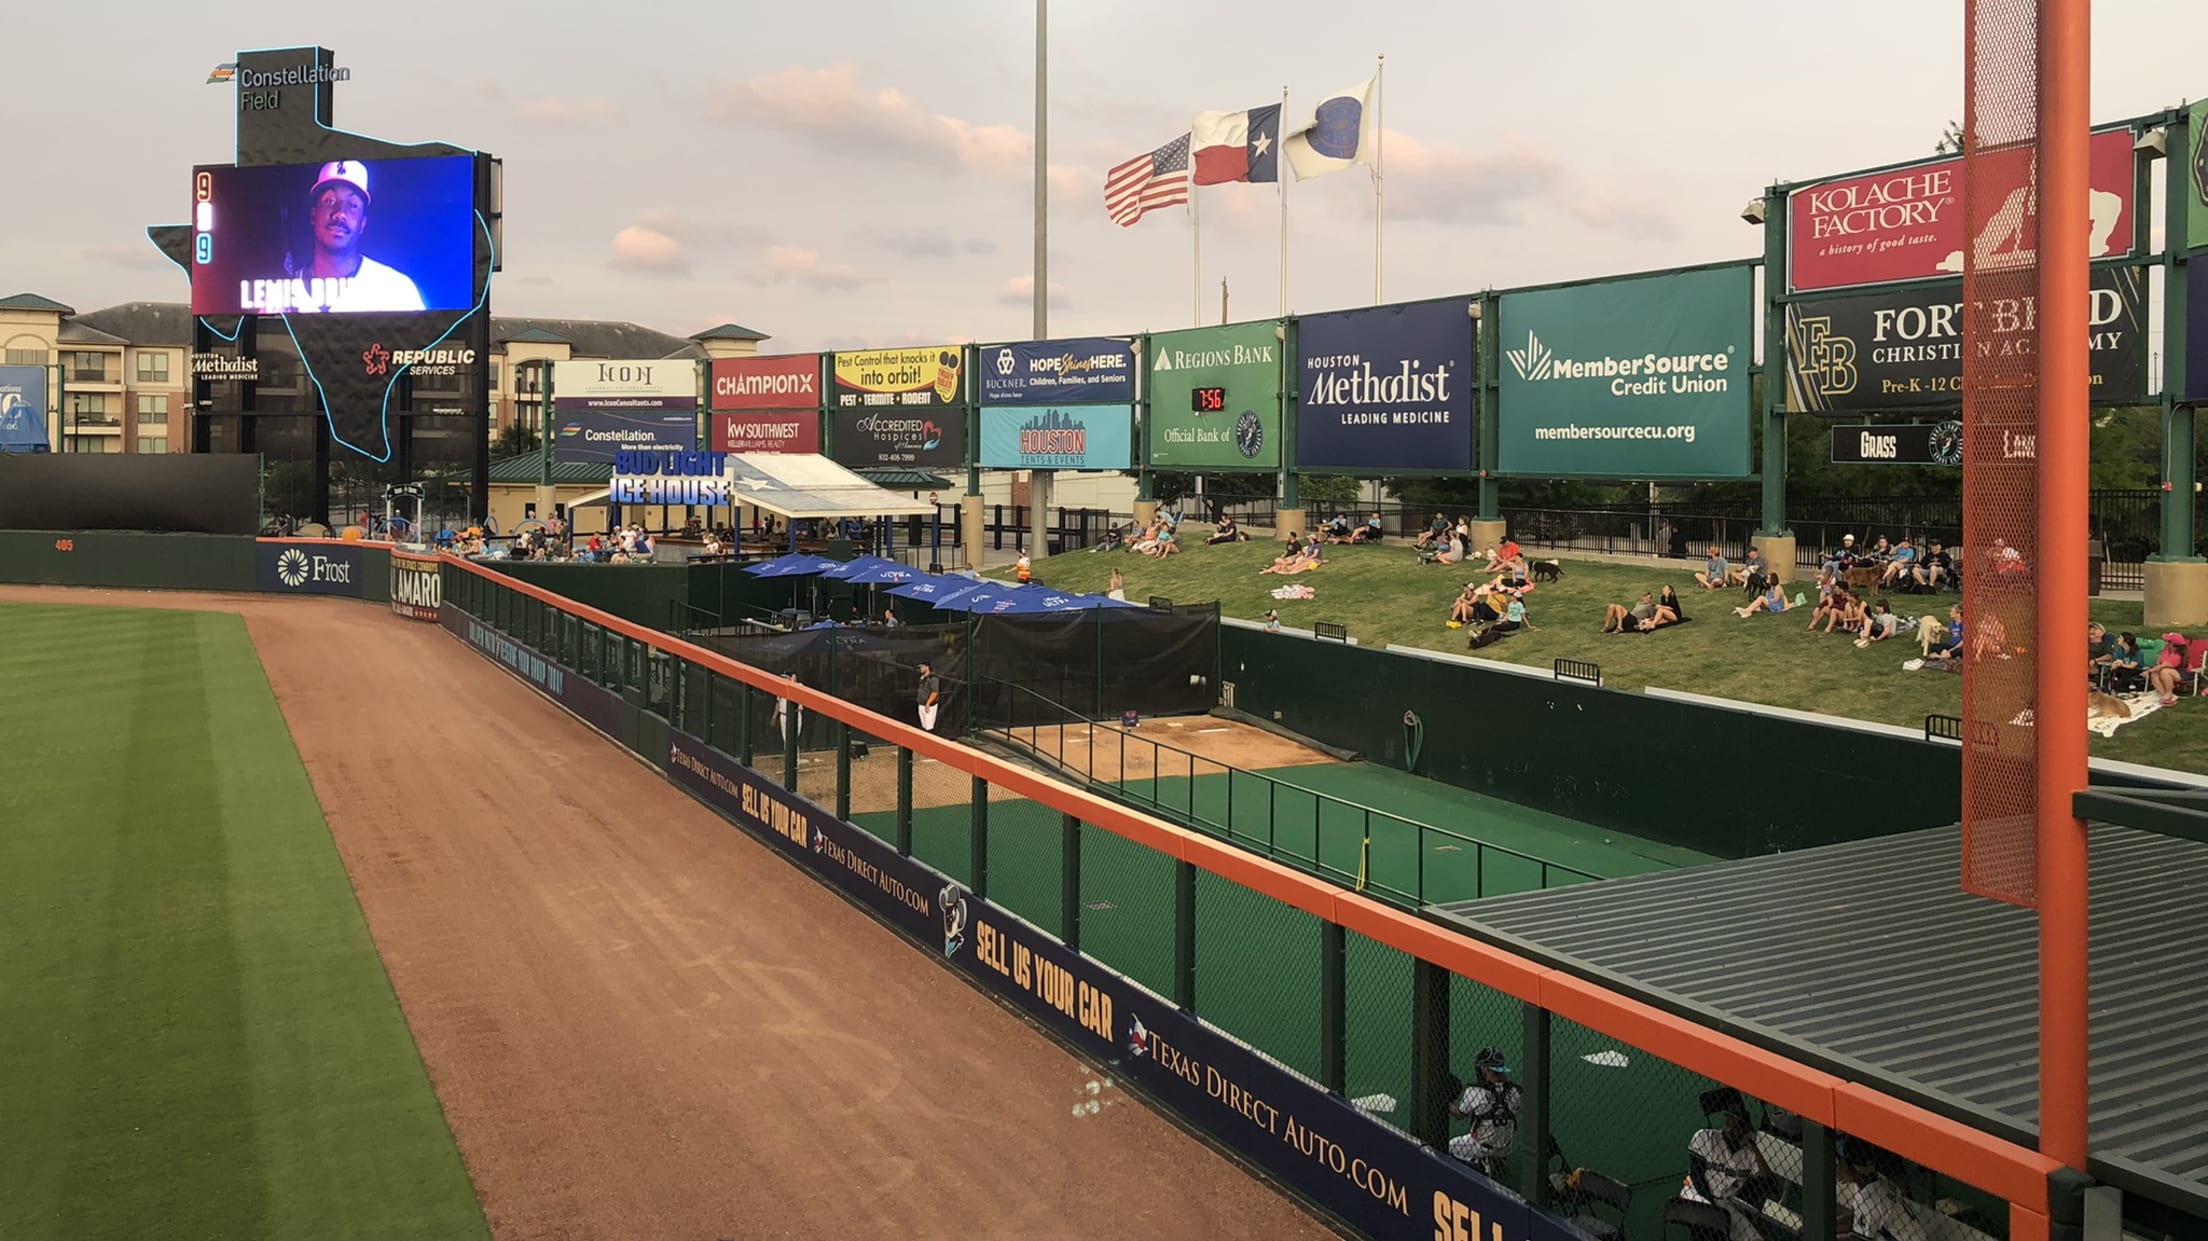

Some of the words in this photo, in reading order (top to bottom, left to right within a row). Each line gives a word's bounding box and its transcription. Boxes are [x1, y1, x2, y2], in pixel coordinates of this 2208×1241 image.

[241, 63, 350, 87] Constellation
[240, 90, 279, 110] Field
[1809, 170, 1951, 215] KOLACHE
[1812, 197, 1945, 239] FACTORY
[1819, 248, 1825, 256] a
[1829, 242, 1863, 256] history
[1866, 238, 1879, 251] of
[1880, 234, 1904, 251] good
[1908, 233, 1937, 245] taste.
[1993, 289, 2122, 333] BD
[2000, 332, 2122, 356] ACMY
[192, 356, 258, 372] Methodist
[392, 350, 476, 365] REPUBLIC
[838, 355, 853, 367] Pest
[854, 353, 882, 367] Control
[883, 352, 899, 365] that
[900, 351, 928, 364] knocks
[930, 350, 936, 363] it
[1030, 358, 1062, 372] HOPE
[1090, 354, 1126, 369] HERE.
[1175, 349, 1231, 370] REGIONS
[1234, 344, 1272, 365] BANK
[1307, 354, 1360, 369] HOUSTON
[1553, 352, 1728, 379] MemberSource
[409, 366, 456, 375] SERVICES
[861, 368, 884, 386] into
[888, 365, 921, 385] orbit!
[1088, 375, 1100, 384] and
[1101, 373, 1126, 383] Seniors
[986, 378, 1026, 389] BUCKNER
[1307, 360, 1450, 405] Methodist
[1611, 377, 1666, 396] Credit
[1671, 374, 1727, 393] Union
[1882, 377, 1921, 394] Pre-K
[840, 394, 857, 406] PEST
[864, 393, 894, 406] TERMITE
[902, 392, 931, 405] RODENT
[1200, 389, 1221, 409] 7:56
[857, 413, 923, 432] ACCREDITED
[1341, 412, 1388, 424] LEADING
[1392, 411, 1450, 424] MEDICINE
[585, 429, 655, 441] Constellation
[746, 423, 799, 438] SOUTHWEST
[874, 432, 922, 442] Hospices
[1164, 427, 1195, 442] Official
[1197, 427, 1219, 442] Bank
[1221, 427, 1231, 442] of
[1535, 423, 1695, 442] membersourcecu.org
[1020, 428, 1086, 454] HOUSTON
[615, 450, 660, 475] BUD
[661, 449, 727, 477] LIGHT
[1021, 455, 1045, 464] TENTS
[1055, 455, 1085, 464] EVENTS
[610, 478, 647, 504] ICE
[651, 479, 731, 506] HOUSE
[56, 539, 73, 551] 405
[312, 556, 350, 583] Frost
[742, 782, 759, 818] SELL
[760, 792, 770, 825] US
[771, 798, 789, 838] YOUR
[790, 810, 808, 849] CAR
[823, 835, 846, 865] TEXAS
[847, 849, 878, 885] DIRECT
[879, 870, 929, 917] AUTO.COM
[976, 919, 1010, 977] SELL
[1013, 940, 1032, 991] US
[1035, 953, 1075, 1020] YOUR
[1078, 980, 1114, 1043] CAR
[1148, 1030, 1200, 1087] TEXAS
[1206, 1064, 1280, 1136] DIRECT
[1283, 1114, 1410, 1217] AUTO.COM
[1433, 1190, 1503, 1241] SE
